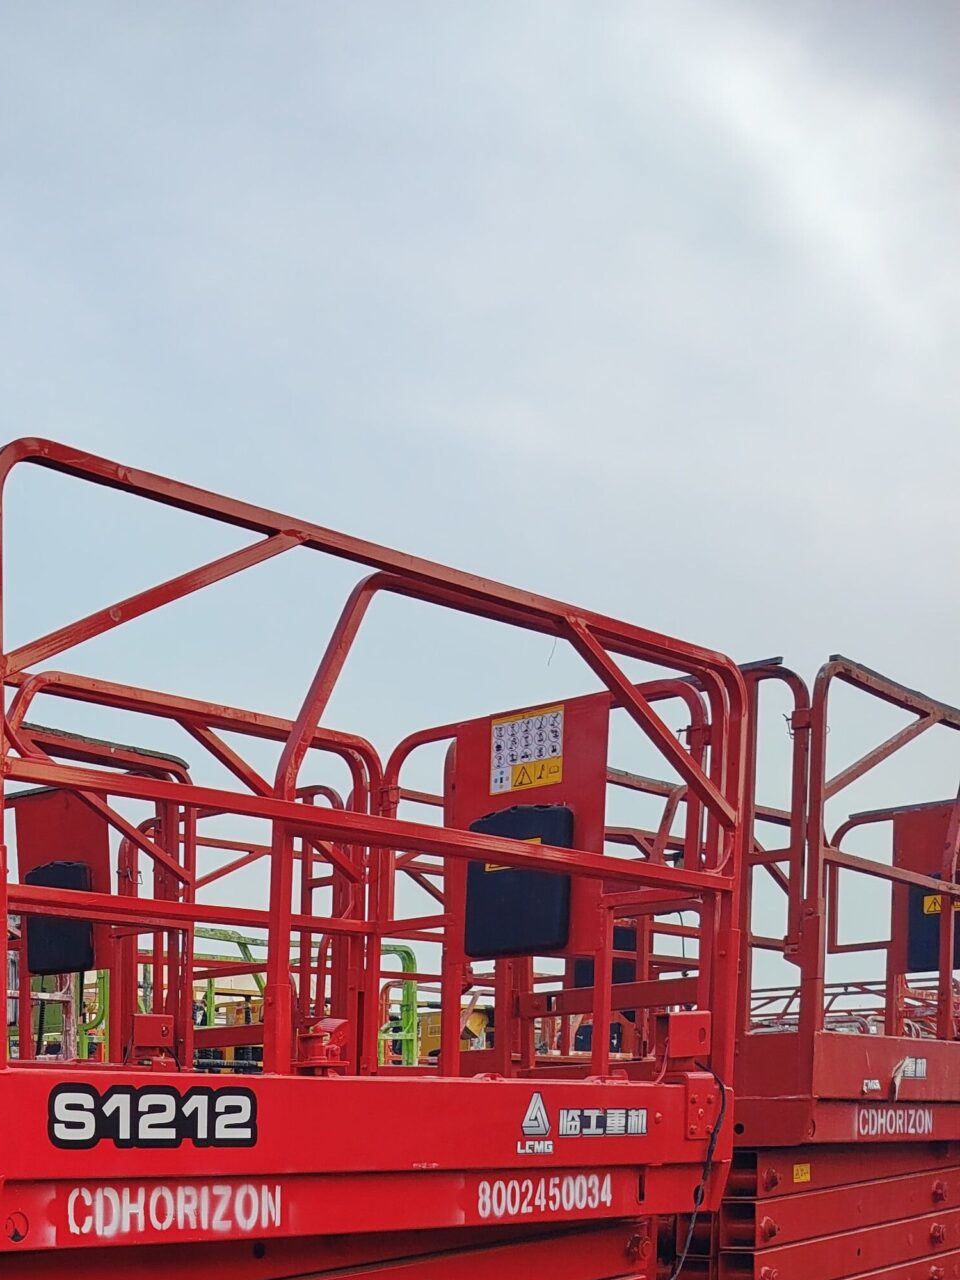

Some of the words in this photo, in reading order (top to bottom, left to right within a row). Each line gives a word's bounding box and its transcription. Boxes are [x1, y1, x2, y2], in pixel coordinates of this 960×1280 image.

[52, 1091, 253, 1141] S1212
[558, 1108, 648, 1136] 临工重机
[859, 1108, 933, 1136] CDHORIZON
[67, 1184, 282, 1238] CDHORIZON
[477, 1173, 613, 1219] 8002450034
